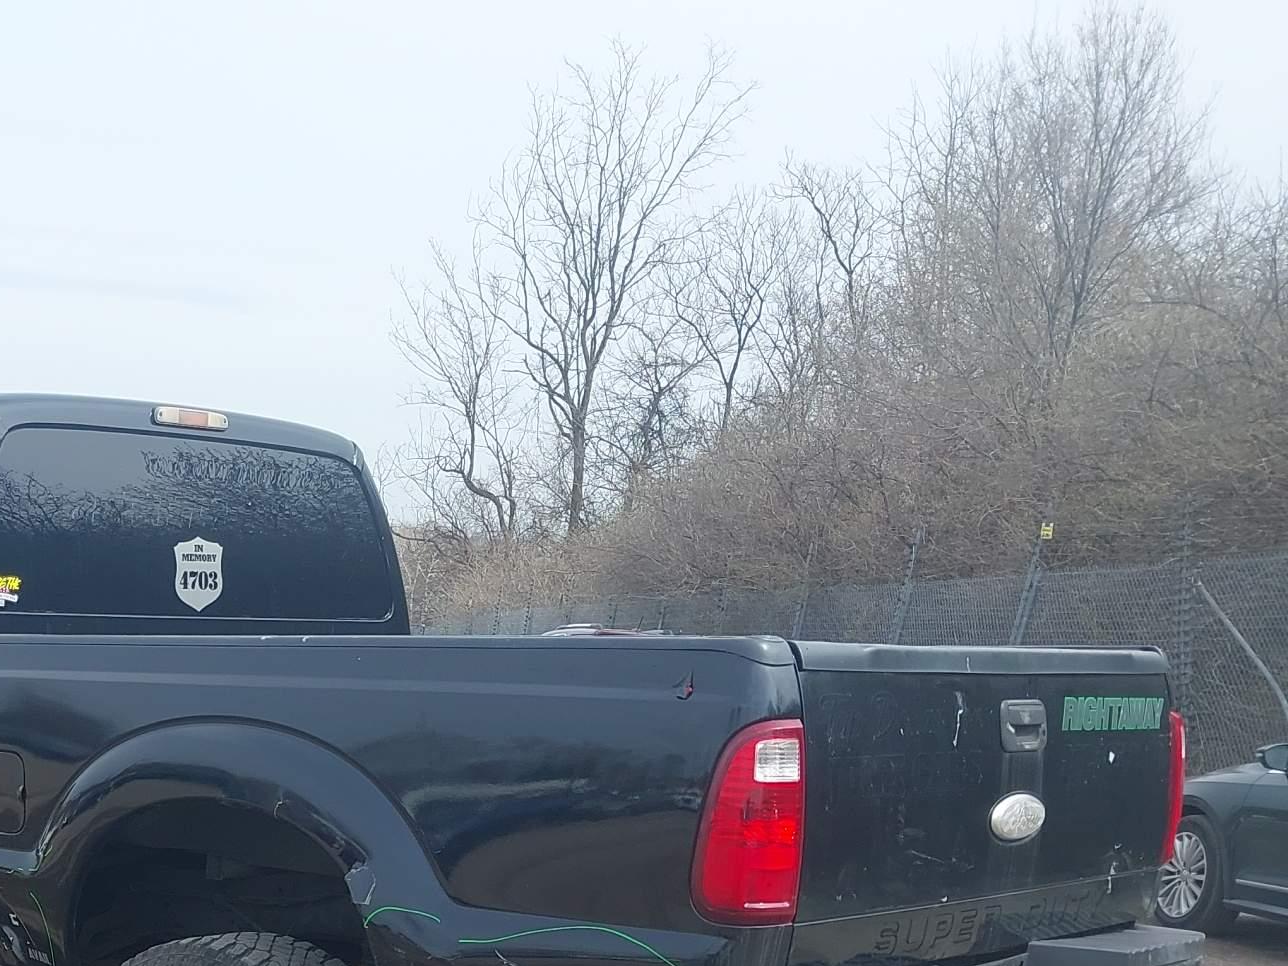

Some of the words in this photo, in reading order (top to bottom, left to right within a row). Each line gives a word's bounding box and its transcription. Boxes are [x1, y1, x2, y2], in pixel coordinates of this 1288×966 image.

[181, 553, 217, 562] MEMORY
[194, 545, 203, 553] IN
[180, 570, 218, 591] 4703
[1062, 696, 1164, 731] RIGHTAWAY
[874, 904, 1002, 955] SUPER
